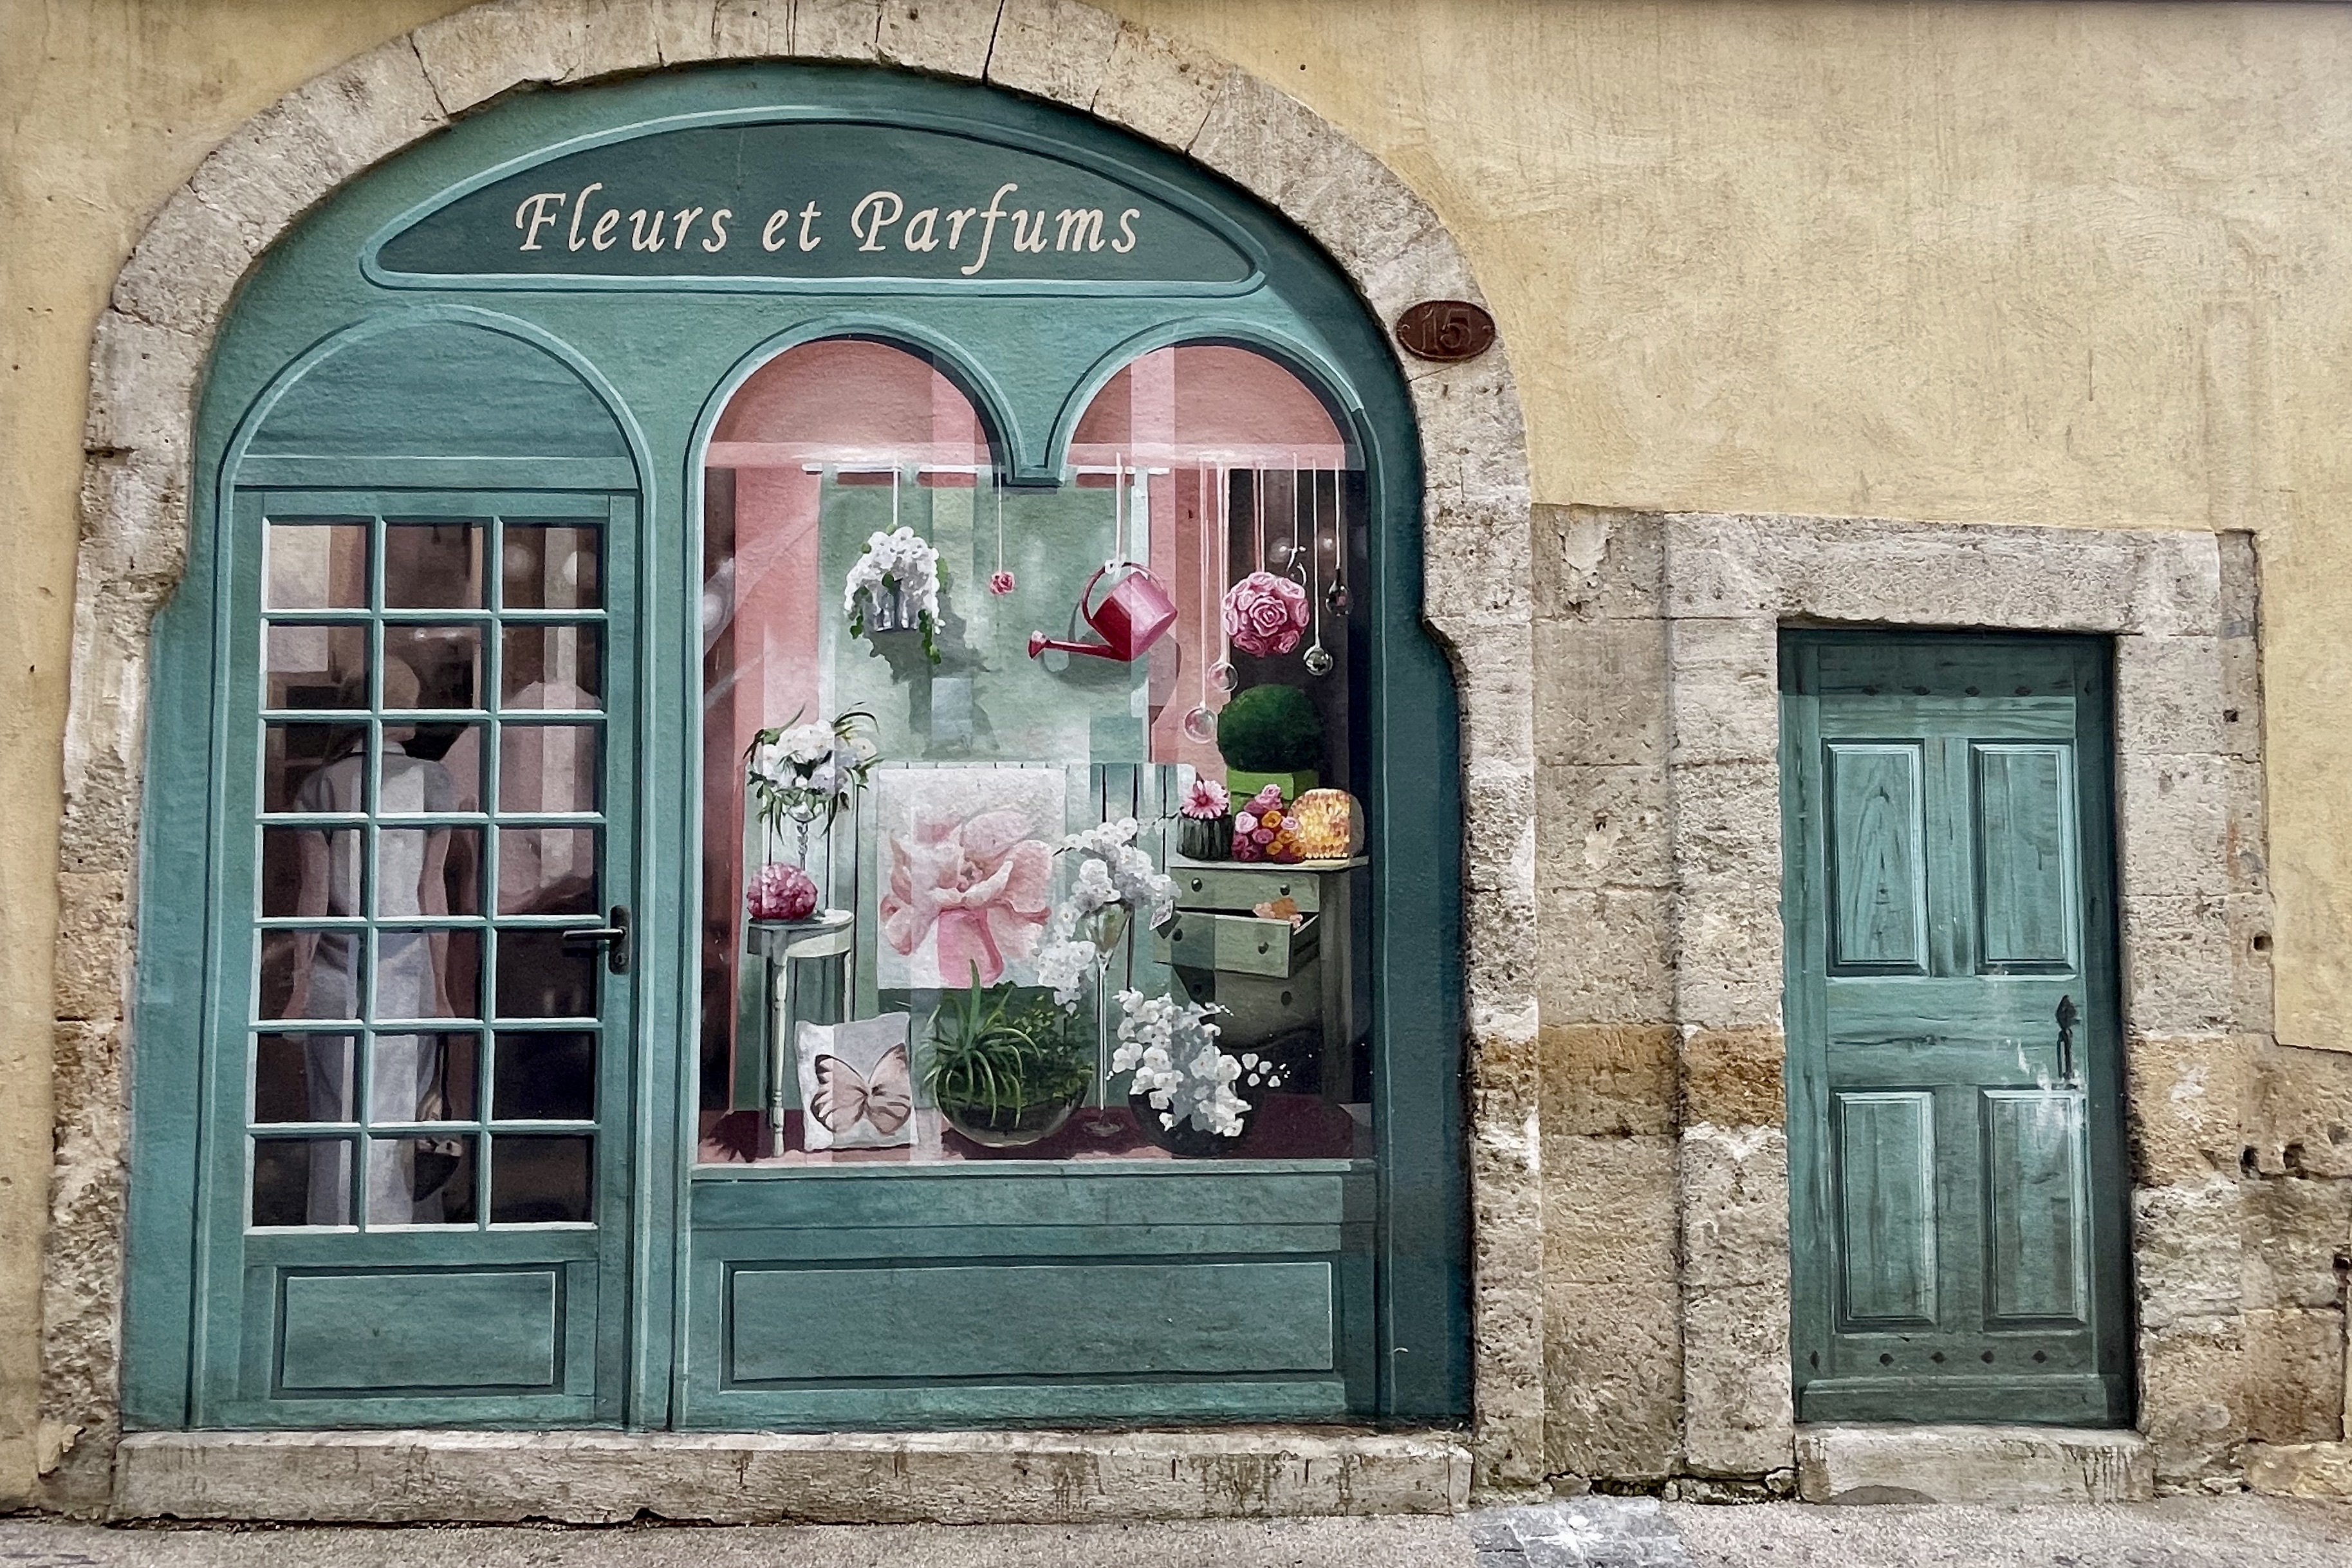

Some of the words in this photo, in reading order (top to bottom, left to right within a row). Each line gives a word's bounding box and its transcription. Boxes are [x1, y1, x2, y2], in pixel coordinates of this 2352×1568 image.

[515, 182, 732, 252] Fleurs
[762, 201, 822, 252] et
[851, 183, 1140, 275] Parfums
[1421, 308, 1472, 351] 15
